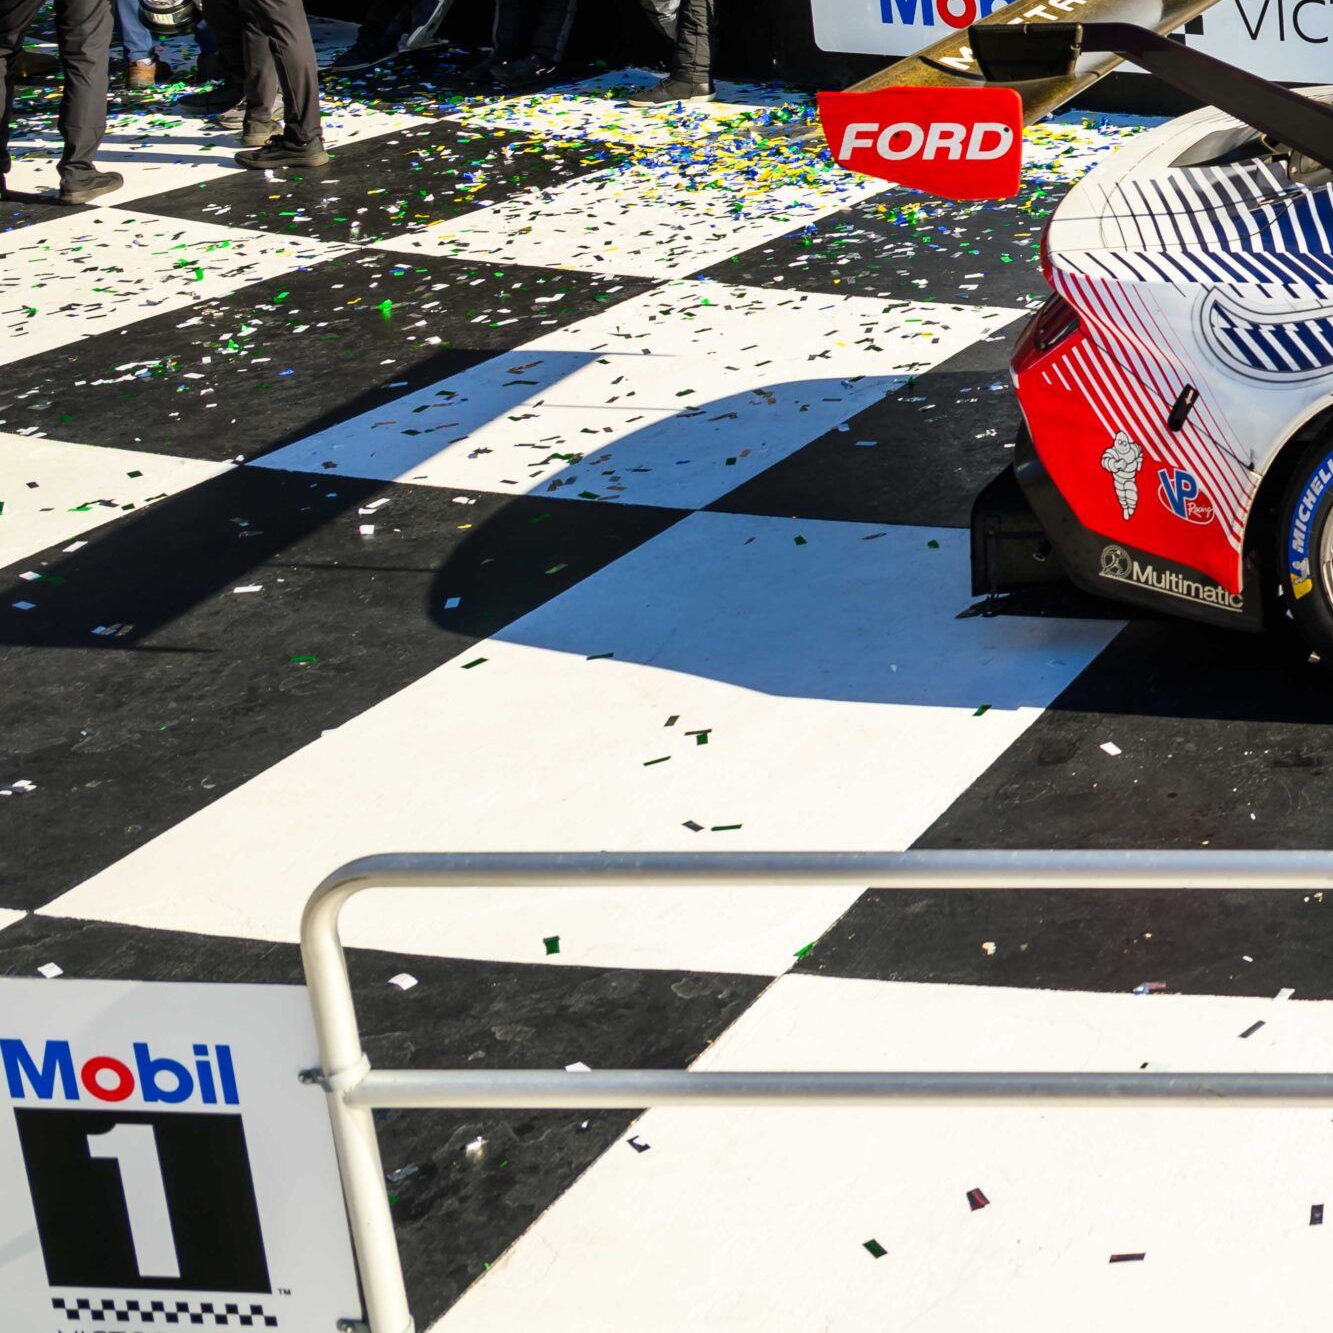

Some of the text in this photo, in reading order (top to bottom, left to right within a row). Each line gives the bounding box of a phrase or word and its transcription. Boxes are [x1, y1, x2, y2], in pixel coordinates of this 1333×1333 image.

[838, 122, 1013, 160] FORD
[1158, 468, 1198, 519] VP
[1188, 503, 1214, 518] Racing
[1133, 561, 1243, 608] Multimatic
[0, 1039, 240, 1105] Mobil
[86, 1123, 181, 1278] 1
